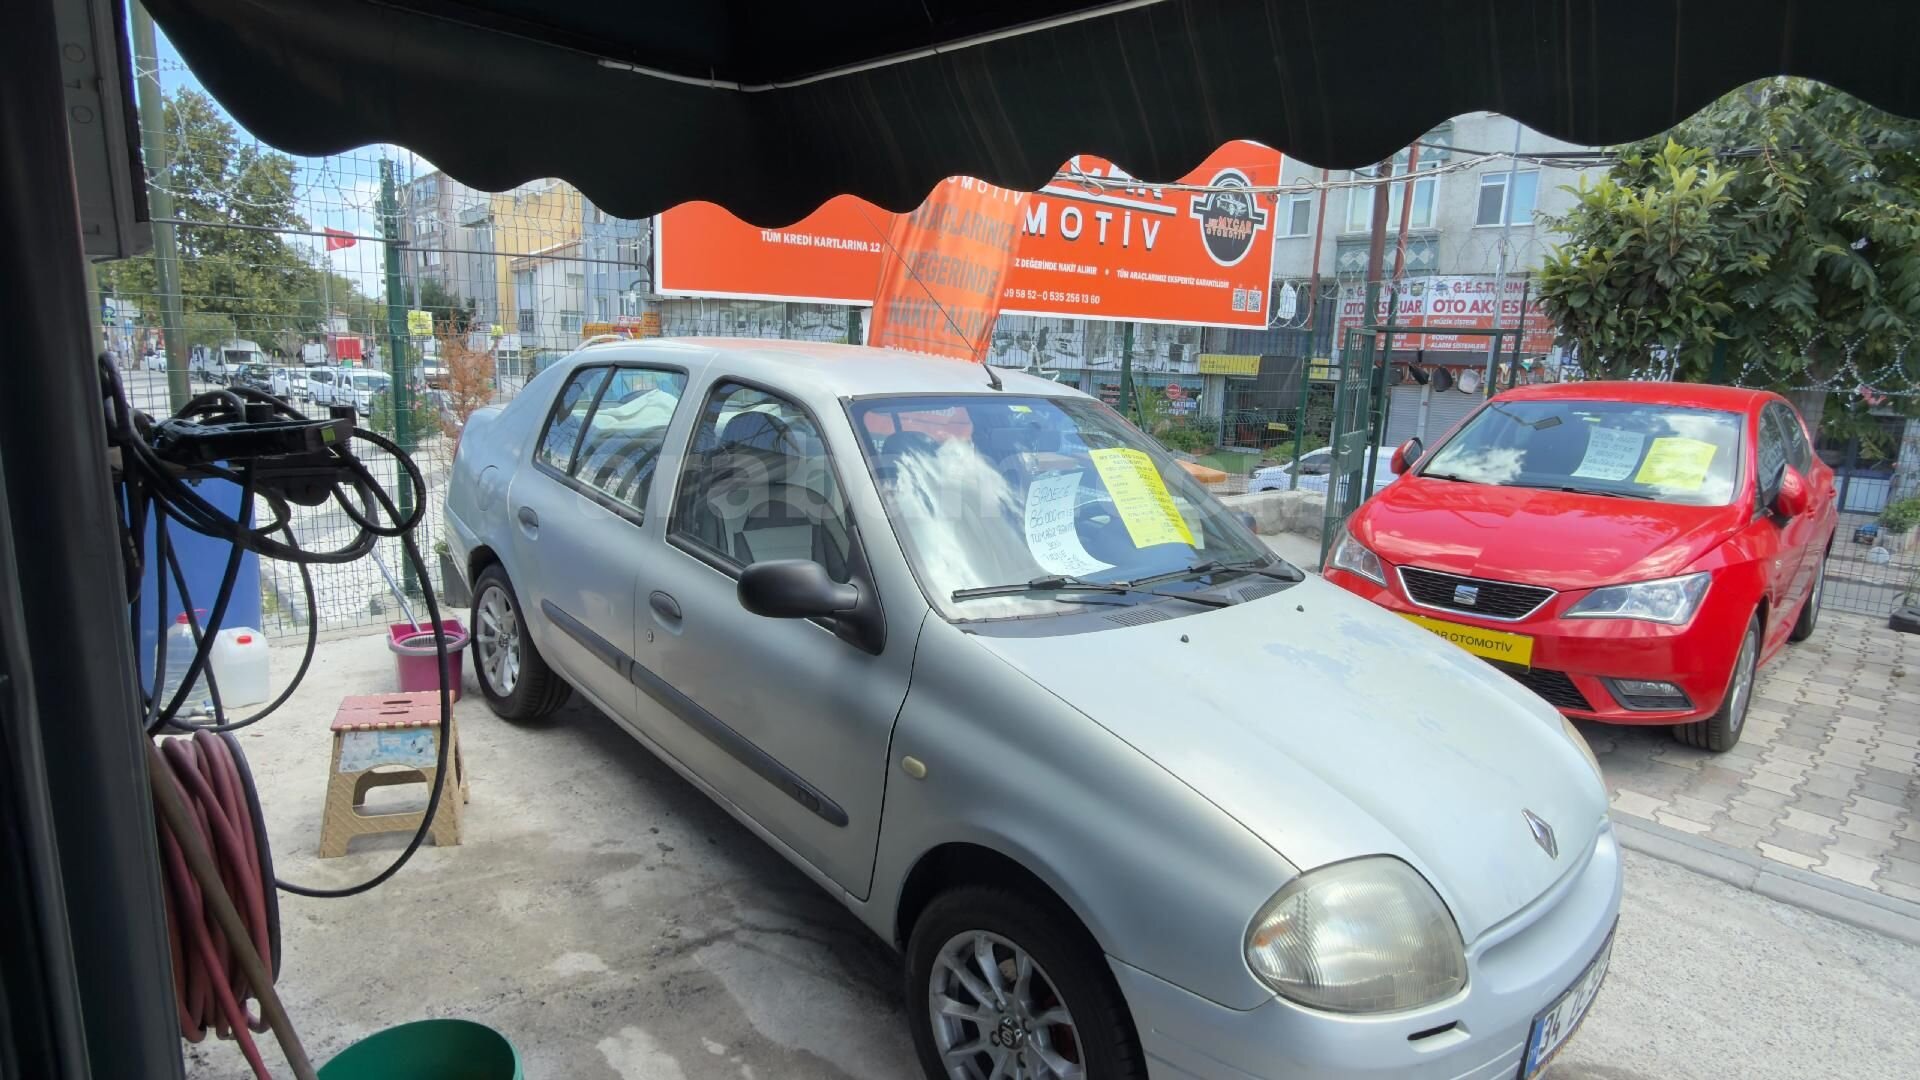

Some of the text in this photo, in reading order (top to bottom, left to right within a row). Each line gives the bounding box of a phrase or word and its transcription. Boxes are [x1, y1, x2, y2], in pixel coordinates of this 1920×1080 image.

[761, 229, 881, 252] TÜM KREDİ KARTLARINA 12
[904, 248, 1000, 299] DEĞERİNDE
[1021, 257, 1057, 271] DEĞERİNDE
[1058, 263, 1077, 273] NAKİT
[1077, 265, 1097, 275] ALINIR
[1116, 268, 1129, 279] TÜM
[1015, 289, 1026, 299] 58
[1049, 291, 1065, 302] 535
[1065, 293, 1080, 304] 256
[1081, 294, 1089, 304] 13
[1090, 295, 1101, 305] 60
[1433, 299, 1466, 313] OTO
[888, 295, 943, 332] NAKİT
[1450, 633, 1513, 653] OTOMOTİV
